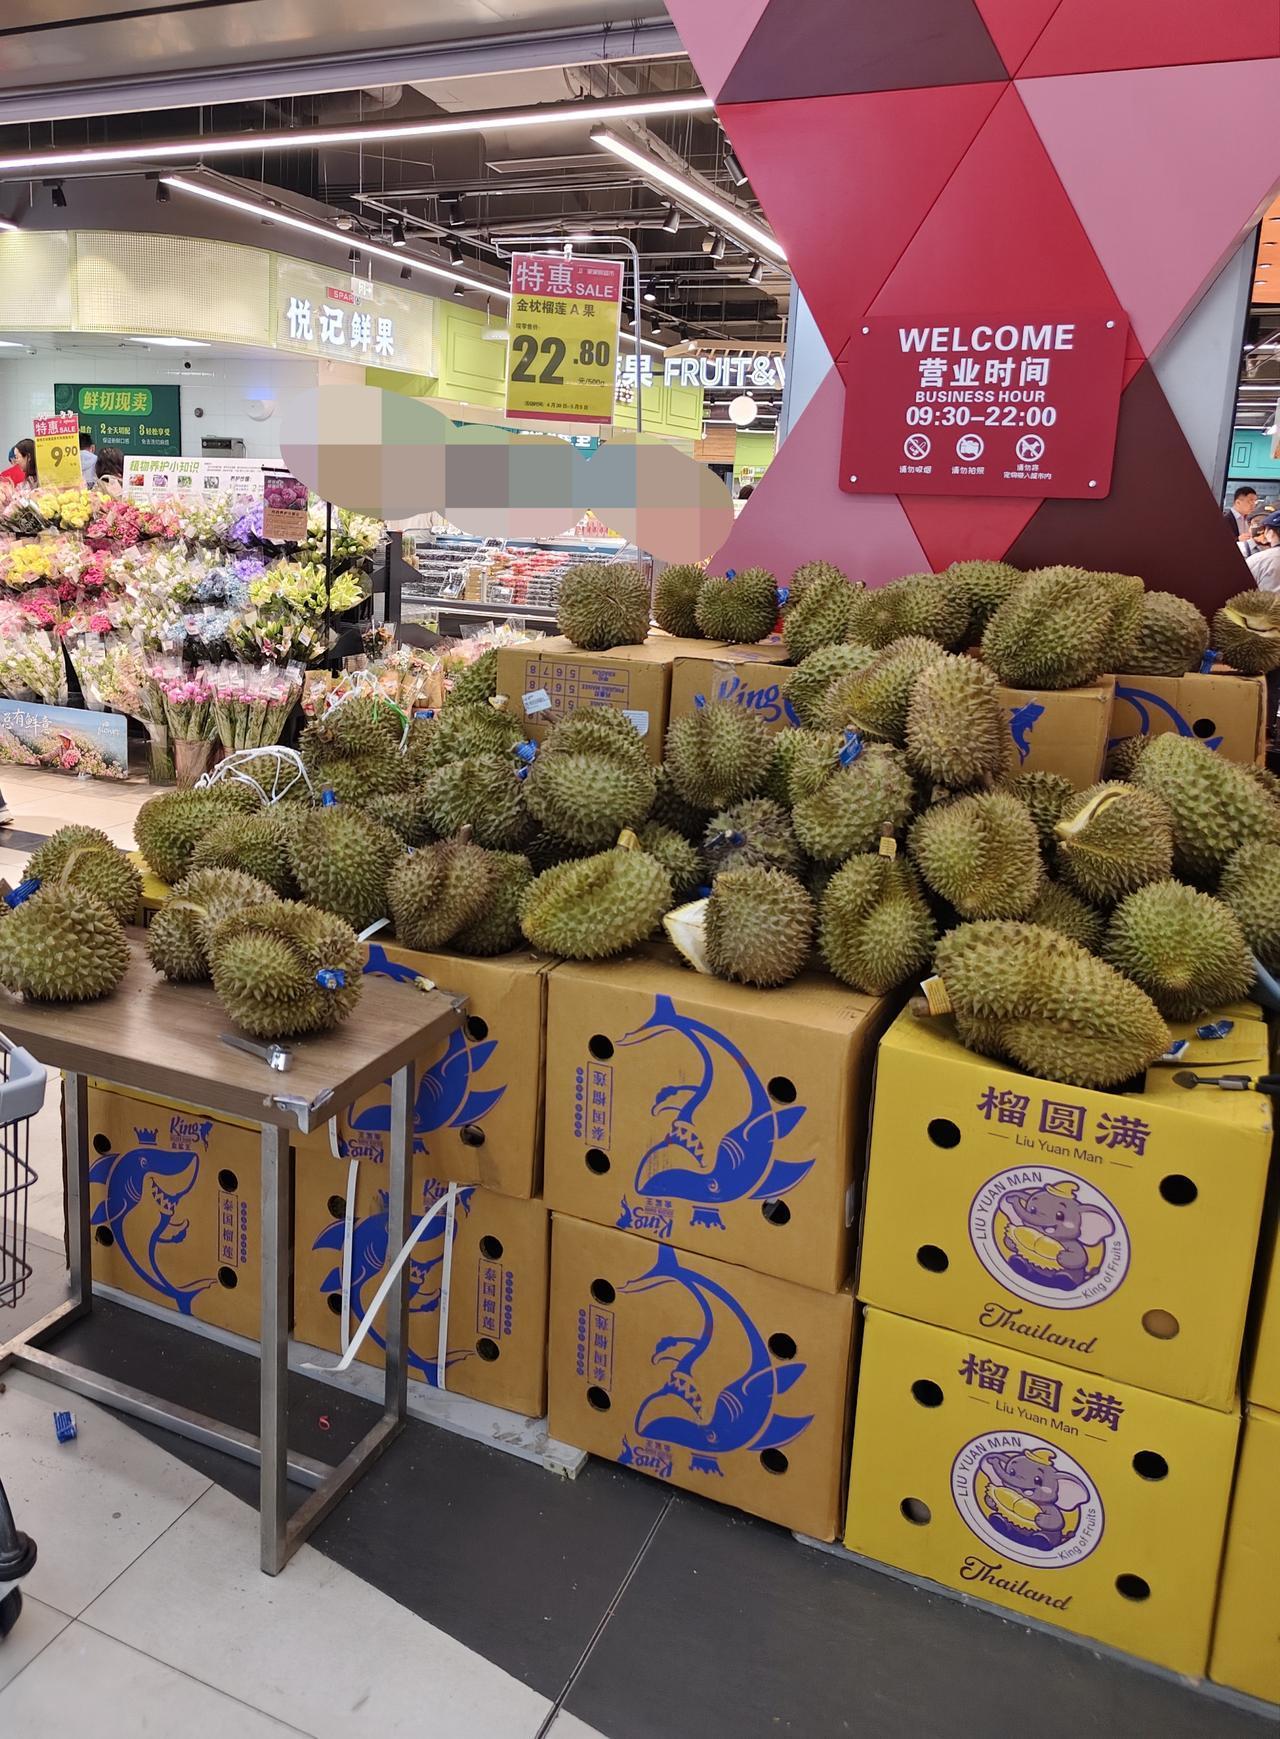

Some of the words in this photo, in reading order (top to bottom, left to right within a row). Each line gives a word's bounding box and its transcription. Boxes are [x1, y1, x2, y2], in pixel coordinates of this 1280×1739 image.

[517, 261, 573, 294] 特惠
[576, 283, 613, 298] SALE
[517, 299, 567, 315] 金枕榴莲
[570, 304, 579, 315] A
[583, 304, 595, 317] 果
[287, 297, 394, 356] 悦记鲜果
[899, 324, 1075, 352] WELCOME
[918, 357, 1050, 387] 营业时间
[83, 391, 147, 411] 鲜切现卖
[915, 390, 995, 403] BUSINESS
[998, 390, 1046, 402] HOUR
[35, 421, 58, 435] 特惠
[59, 426, 76, 434] SALE
[100, 423, 106, 434] 2
[139, 424, 145, 435] 3
[51, 446, 78, 467] 9.90
[130, 460, 199, 473] 植物养护小知识
[952, 466, 984, 475] 请勿拍照
[530, 665, 537, 673] 8
[544, 667, 549, 675] 7
[556, 668, 563, 676] 6
[570, 669, 576, 678] 5
[530, 680, 536, 689] 8
[555, 683, 562, 692] 6
[569, 685, 576, 693] 5
[555, 698, 561, 707] 6
[592, 1070, 607, 1142] 泰国榴莲
[170, 1116, 200, 1142] King
[976, 1086, 1152, 1157] 榴圆满
[348, 1139, 384, 1164] King
[1016, 1134, 1034, 1148] Liu
[1038, 1139, 1070, 1158] Yuan
[1074, 1148, 1103, 1164] Man
[1008, 1171, 1042, 1188] MAN
[977, 1182, 1006, 1214] YUAN
[223, 1199, 233, 1260] 泰国榴莲
[632, 1207, 673, 1239] King
[976, 1216, 988, 1240] LIU
[1081, 1280, 1107, 1300] King
[1104, 1265, 1113, 1283] of
[1109, 1240, 1122, 1270] Fruits
[482, 1267, 497, 1331] 泰国榴莲
[979, 1302, 1099, 1354] Thailand
[593, 1314, 608, 1382] 泰国榴莲
[958, 1353, 1125, 1432] 榴圆满
[996, 1400, 1014, 1415] Liu
[1017, 1406, 1048, 1426] Yuan
[1050, 1419, 1079, 1436] Man
[988, 1436, 1022, 1452] MAN
[633, 1447, 672, 1477] King
[959, 1442, 986, 1473] YUAN
[958, 1473, 968, 1497] LIU
[1083, 1507, 1097, 1537] Fruits
[1058, 1541, 1081, 1561] King
[1078, 1530, 1089, 1548] of
[959, 1555, 1073, 1611] Thailand
